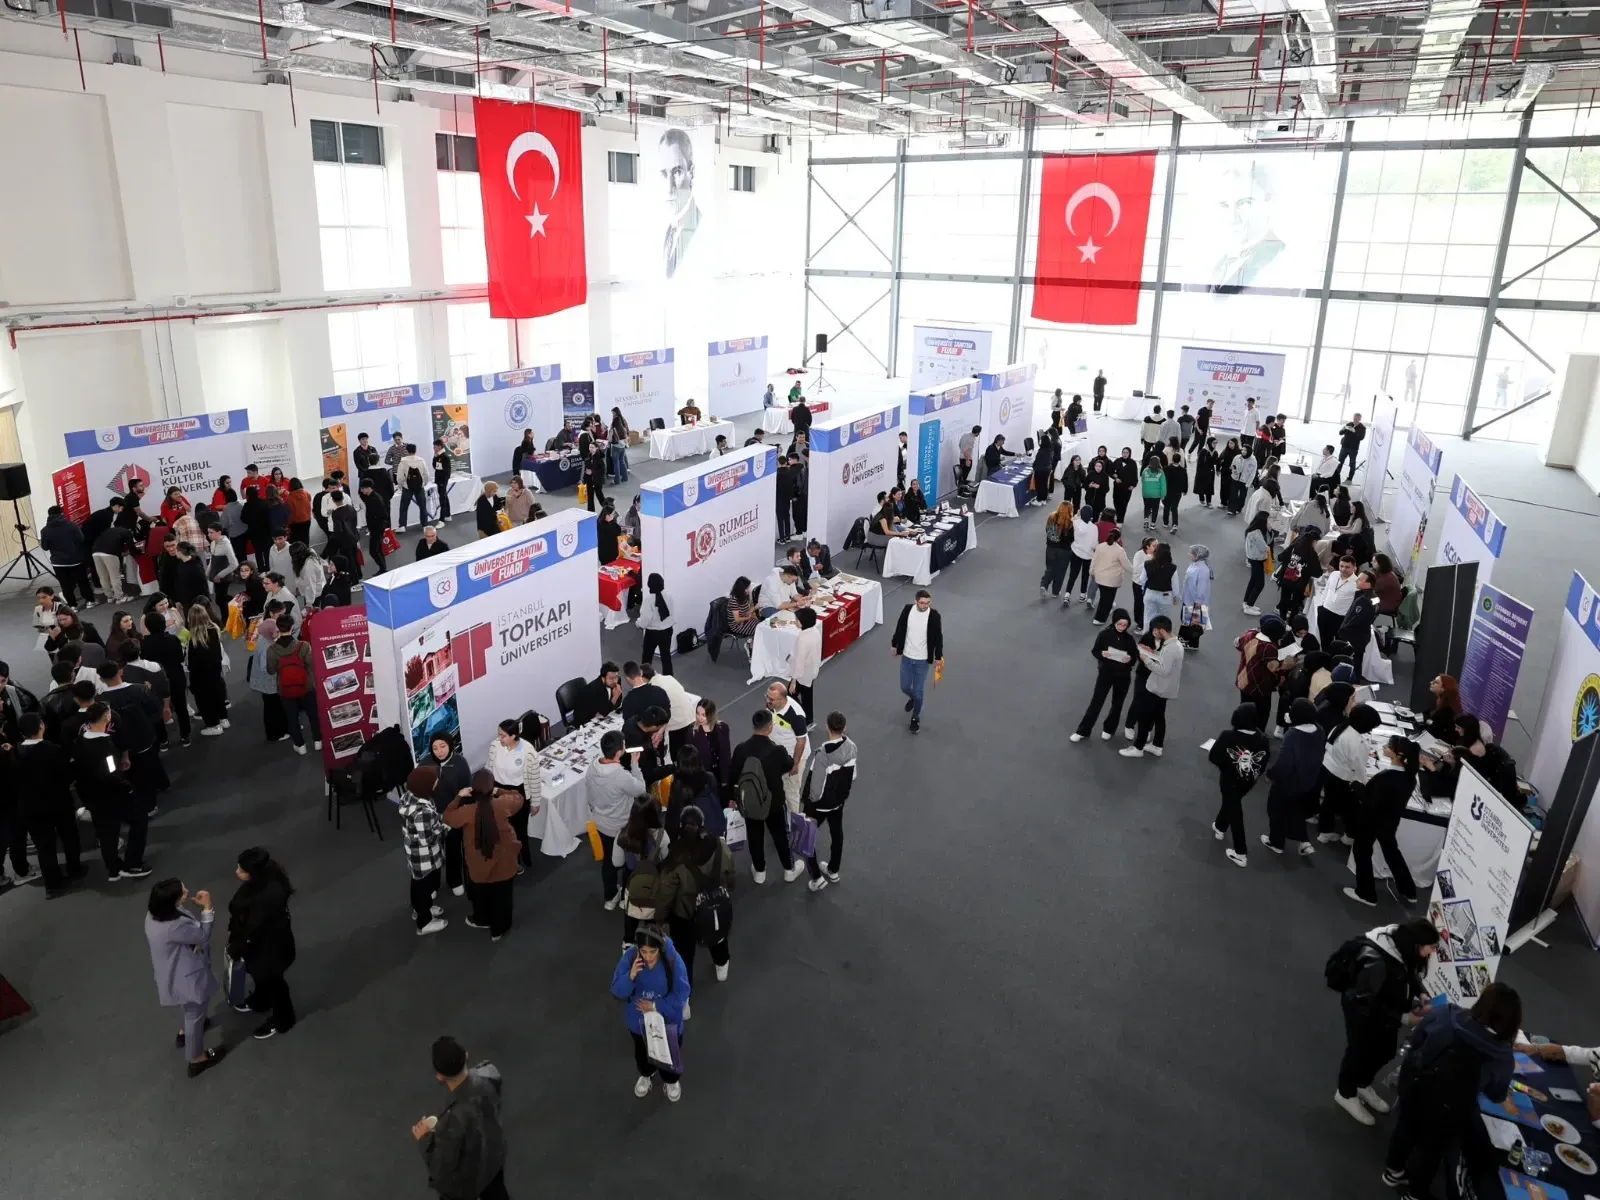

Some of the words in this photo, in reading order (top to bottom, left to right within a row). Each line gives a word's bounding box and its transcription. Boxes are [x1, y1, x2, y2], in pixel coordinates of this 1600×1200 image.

[1218, 372, 1240, 381] FUARI
[134, 422, 170, 435] ÜNİVERSİTE
[171, 420, 196, 430] TANITIM
[156, 430, 178, 441] FUARI
[158, 456, 178, 466] T.C.
[160, 460, 212, 476] İSTANBUL
[852, 460, 868, 474] KENT
[162, 472, 204, 487] KÜLTÜR
[719, 504, 758, 536] RUMELİ
[474, 552, 514, 576] ÜNİVERSİTE
[516, 541, 543, 559] TANITIM
[498, 560, 523, 581] FUARI
[498, 599, 545, 628] İSTANBUL
[499, 600, 570, 648] TOPKAPI
[500, 620, 572, 666] ÜNİVERSİTESİ
